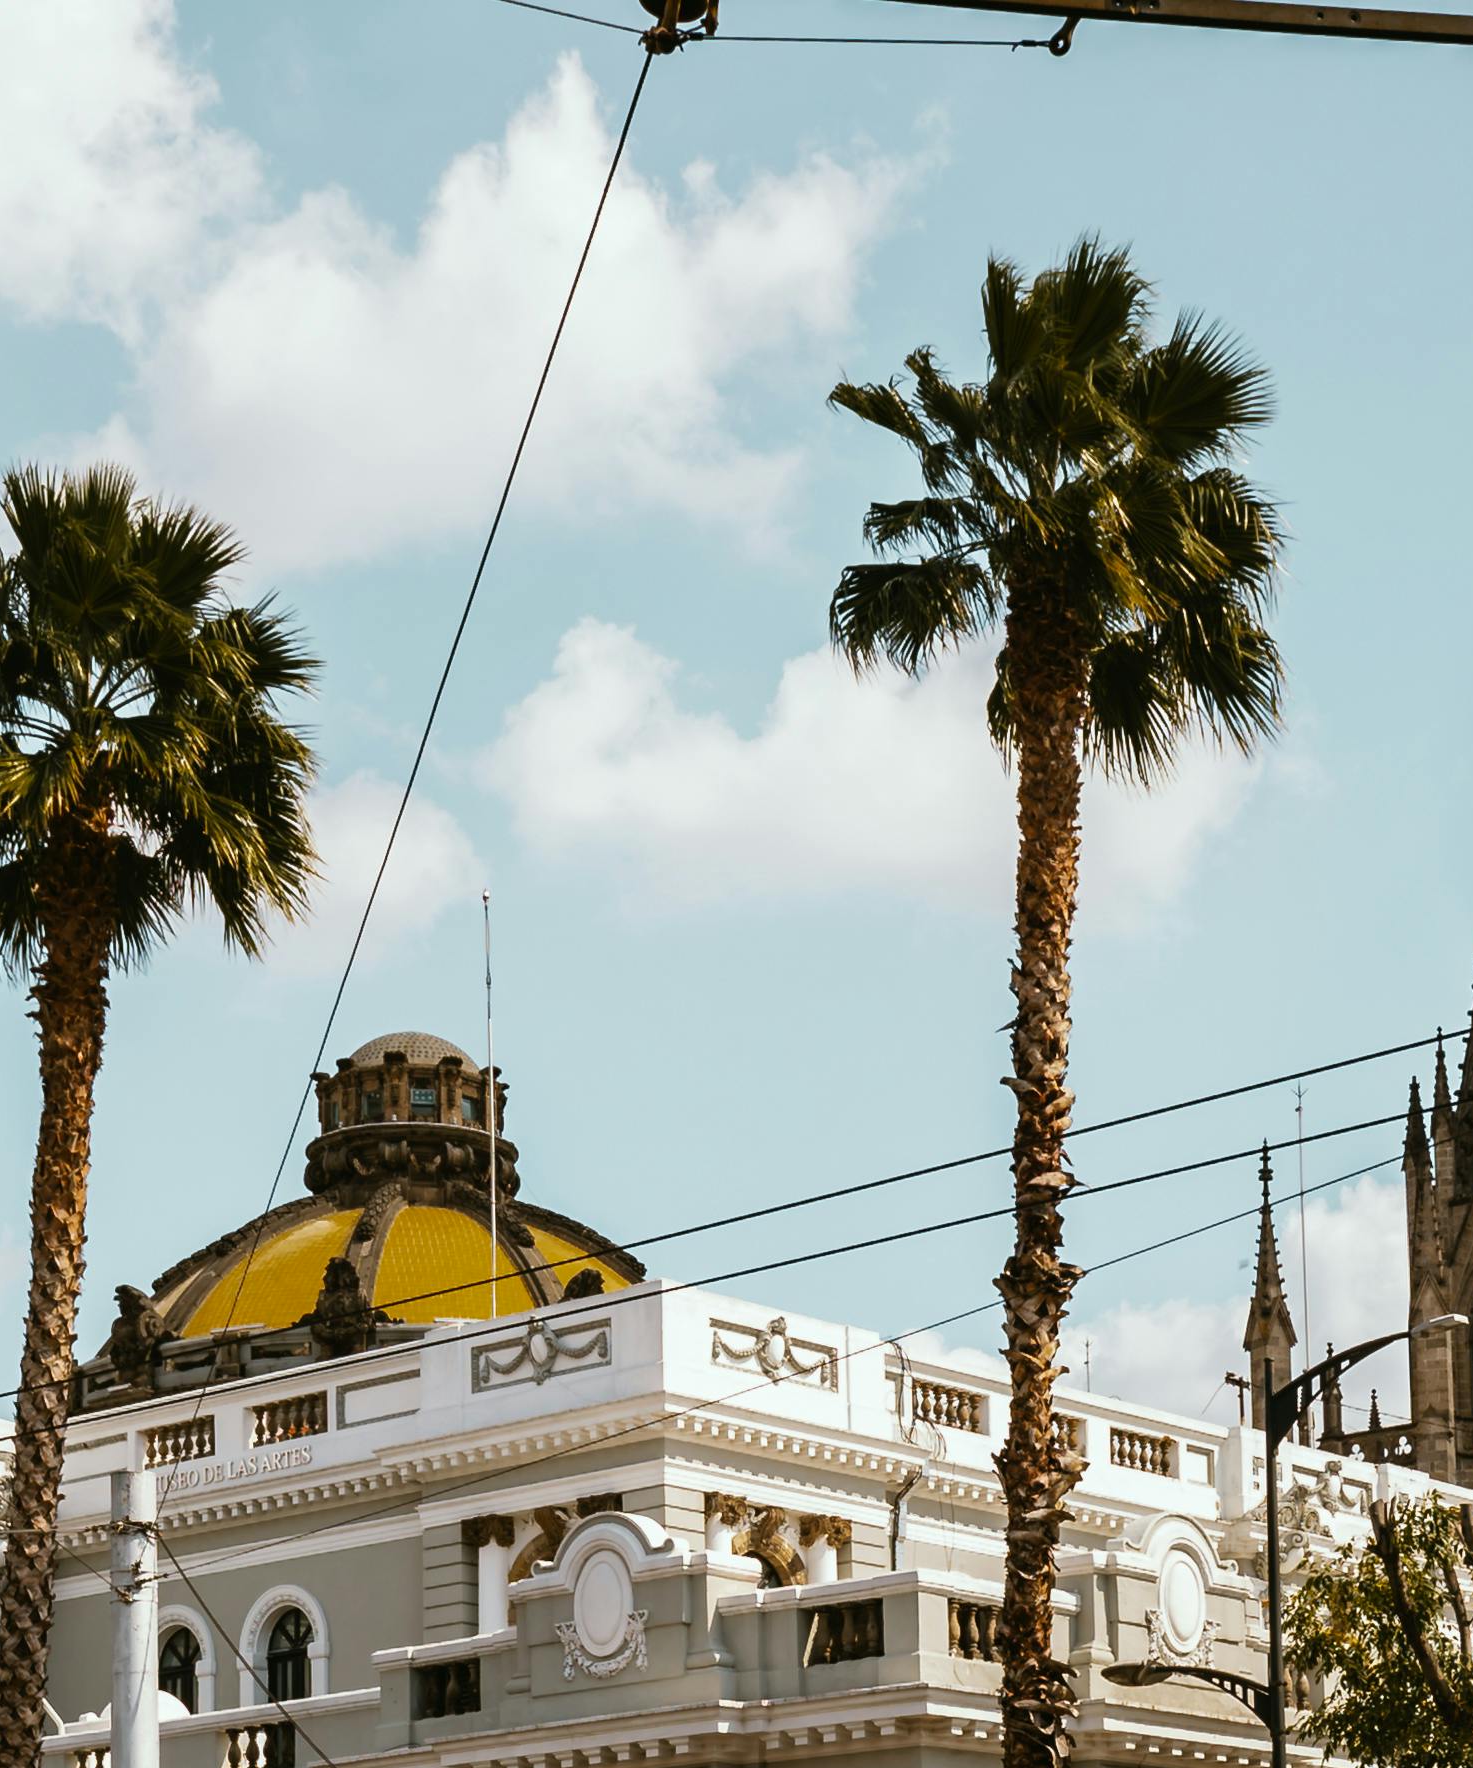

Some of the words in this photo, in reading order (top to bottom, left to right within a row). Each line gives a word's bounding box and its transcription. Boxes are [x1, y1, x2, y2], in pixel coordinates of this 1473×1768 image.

[156, 1470, 200, 1494] USEO
[203, 1465, 224, 1485] DE
[227, 1456, 258, 1479] LAS
[260, 1445, 313, 1474] ARTES
